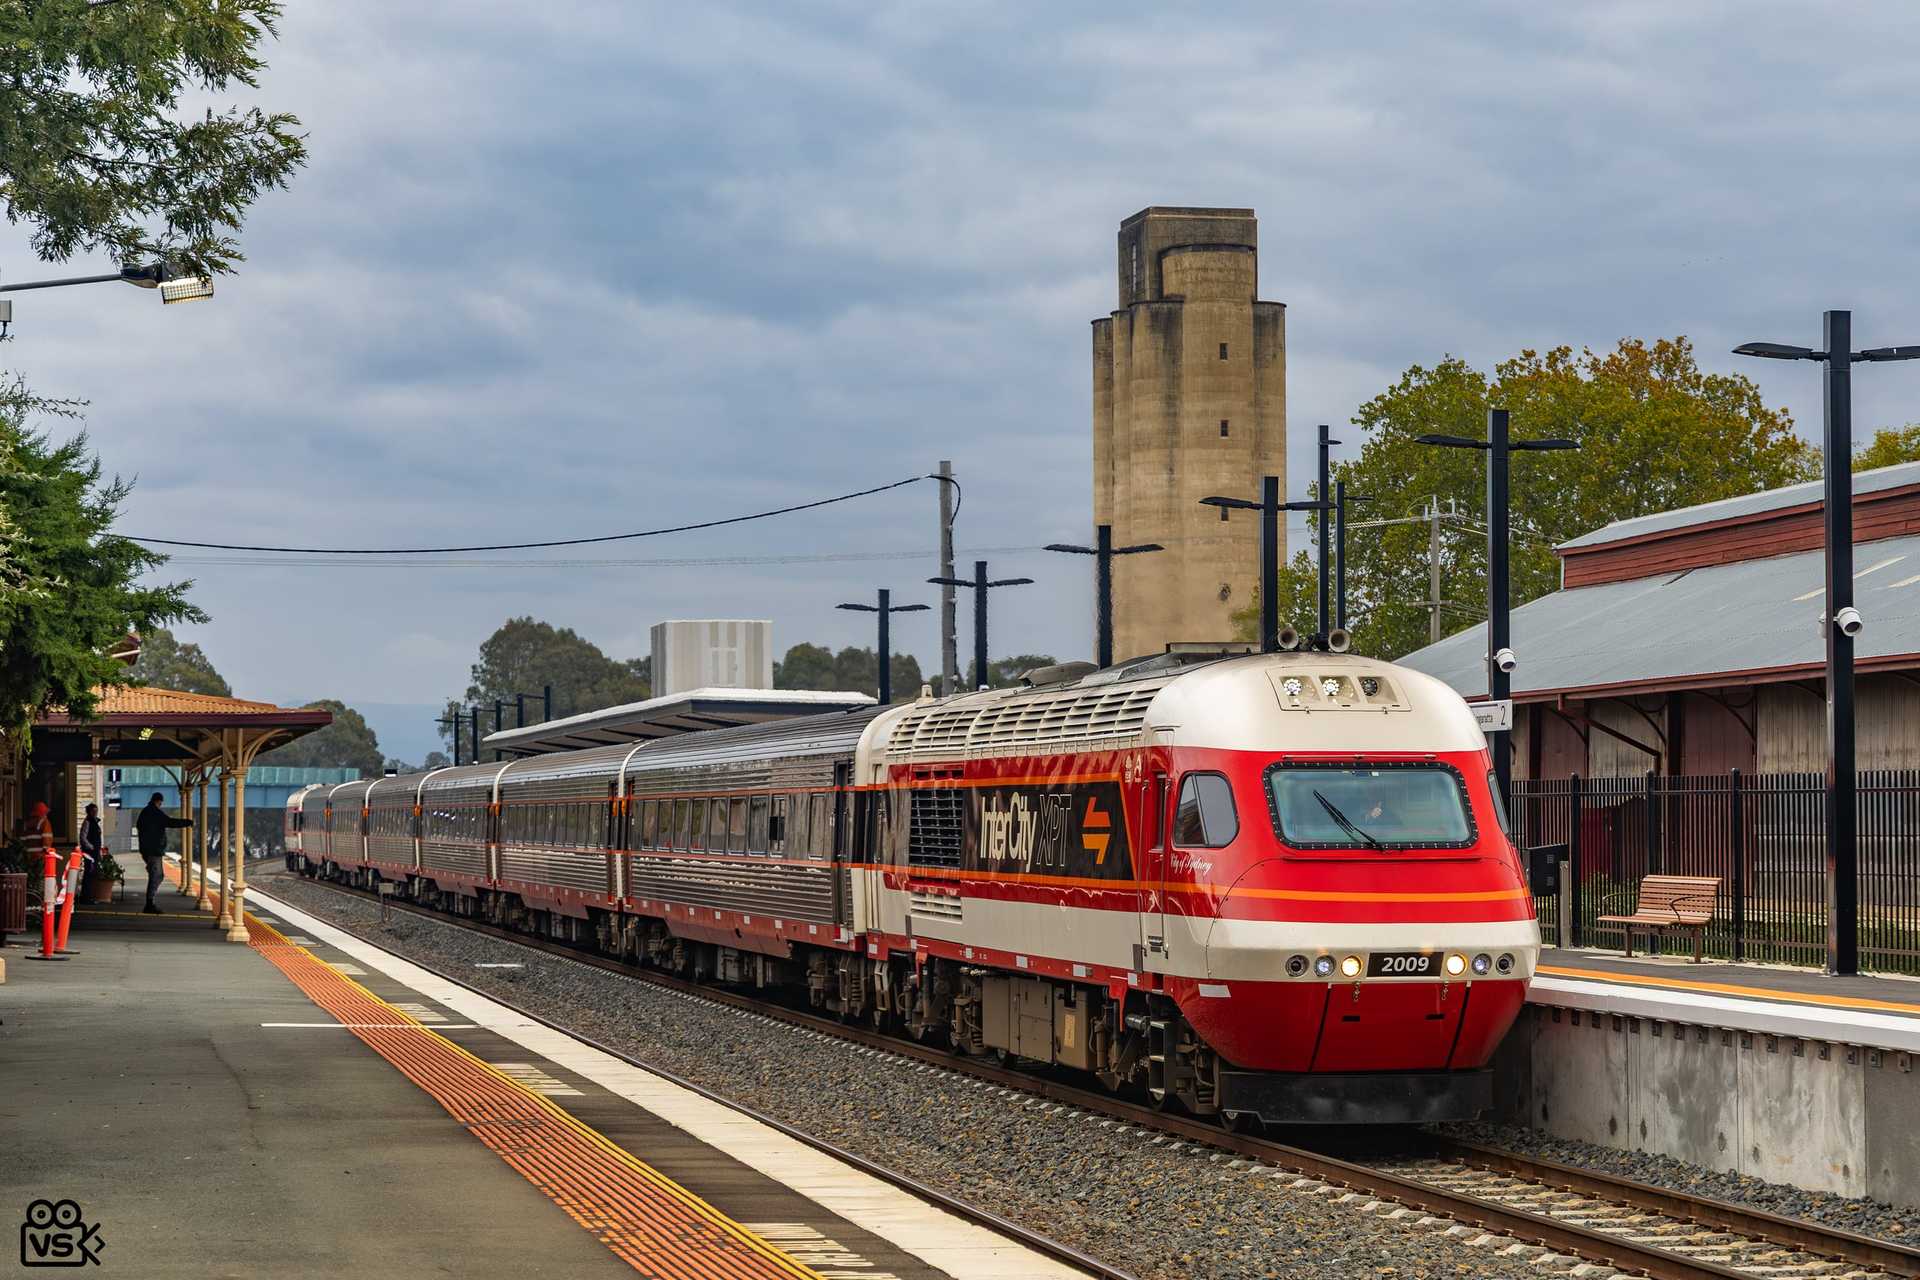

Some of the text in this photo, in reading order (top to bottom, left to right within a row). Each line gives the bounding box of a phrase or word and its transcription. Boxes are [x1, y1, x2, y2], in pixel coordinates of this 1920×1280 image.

[1500, 705, 1506, 725] 2
[980, 792, 1072, 873] InterCity XPT
[1185, 853, 1213, 876] Sydney
[1381, 956, 1430, 972] 2009
